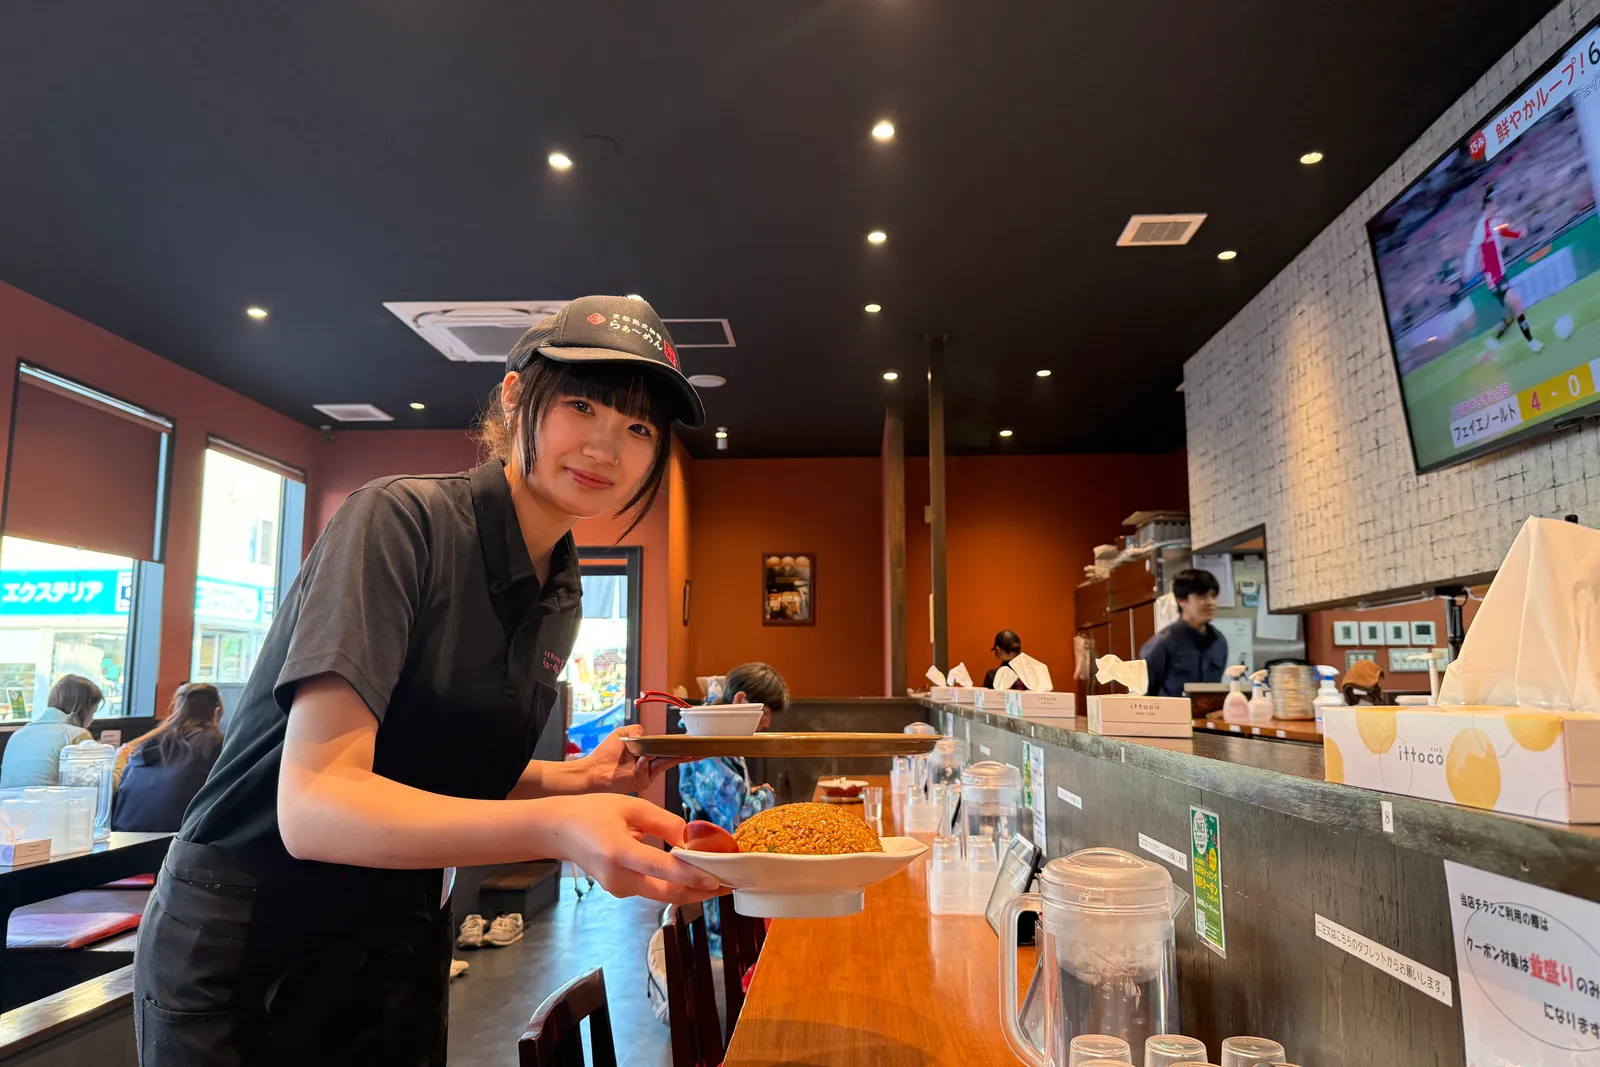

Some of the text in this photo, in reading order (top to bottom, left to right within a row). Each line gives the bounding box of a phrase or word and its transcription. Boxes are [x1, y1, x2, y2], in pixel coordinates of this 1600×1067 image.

[1531, 390, 1541, 411] 4
[1567, 374, 1580, 397] 0
[1453, 403, 1516, 441] フェイエノールト
[3, 581, 104, 602] エクステリア
[1130, 702, 1160, 710] ittoco
[1398, 745, 1444, 766] ittoco
[1384, 810, 1391, 825] 8
[1460, 893, 1549, 932] 当店チラシご利用の際は
